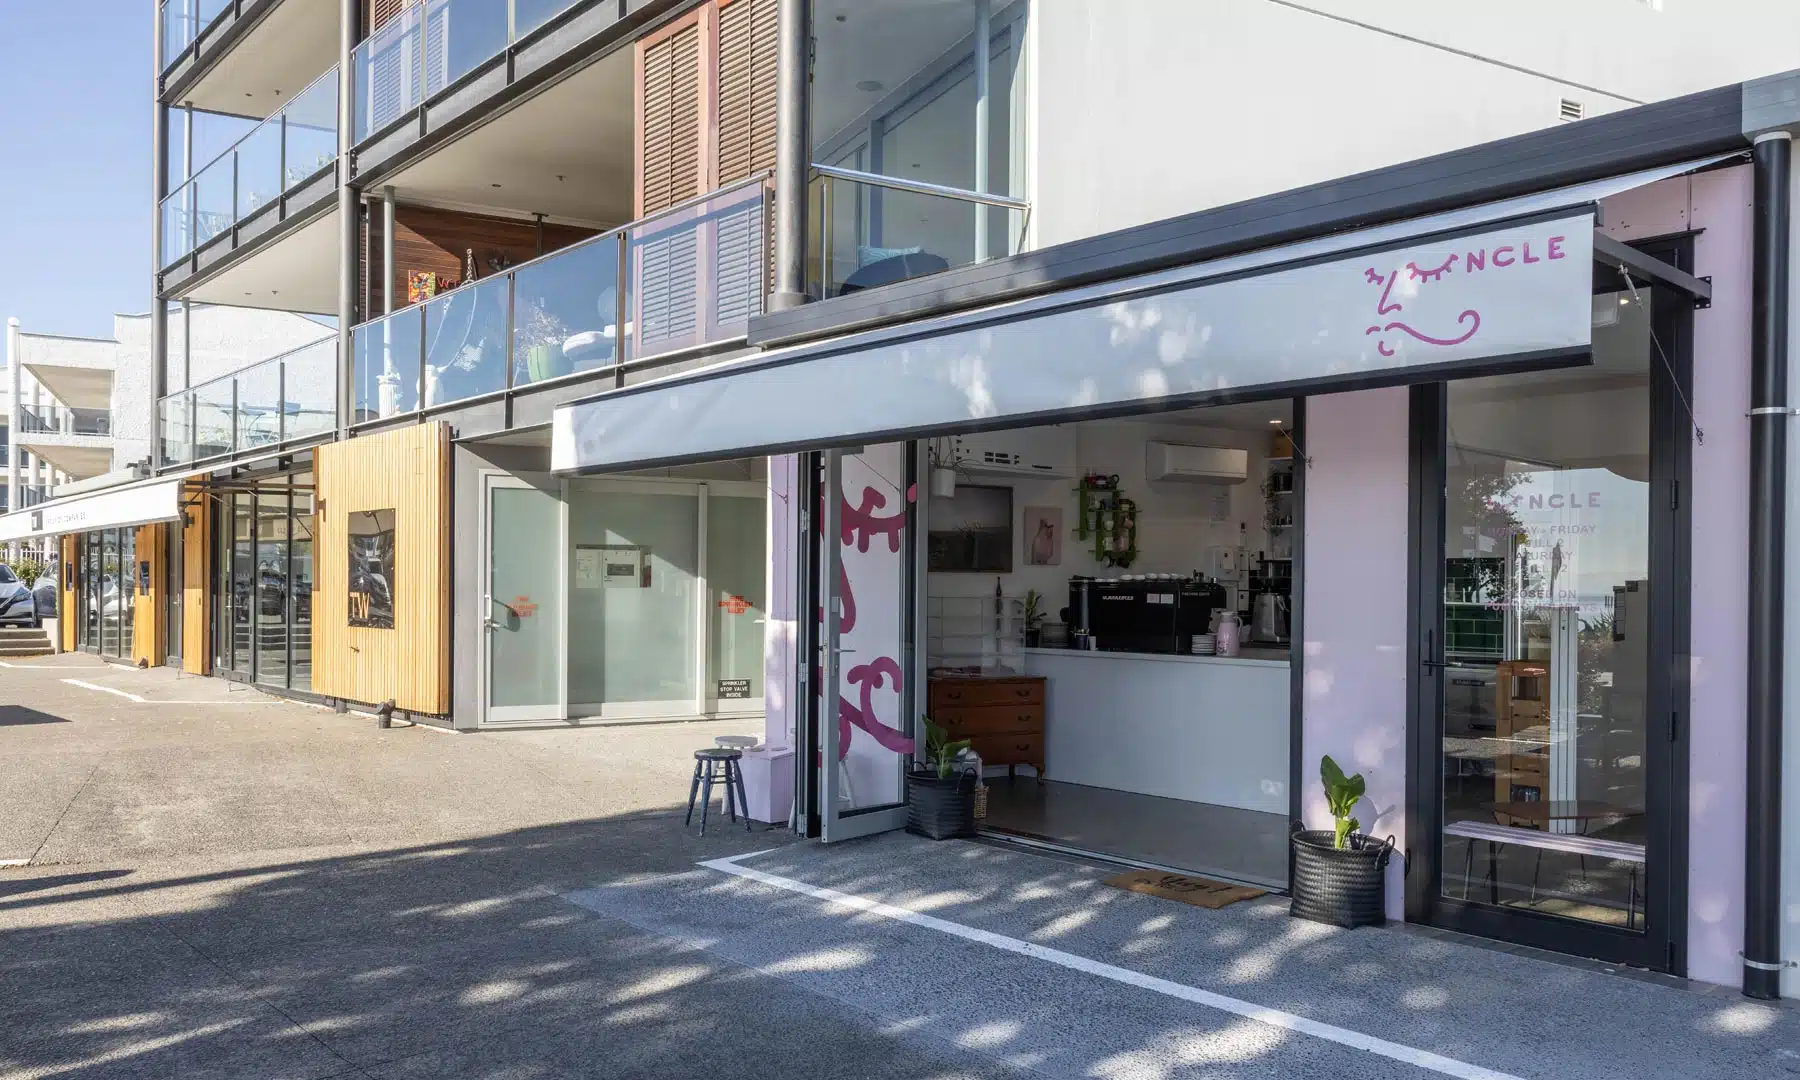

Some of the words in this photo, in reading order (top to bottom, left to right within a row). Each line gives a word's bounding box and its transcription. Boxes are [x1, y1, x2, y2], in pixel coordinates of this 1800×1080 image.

[1550, 525, 1597, 535] FRIDAY
[1507, 551, 1573, 561] ATURDAY
[1558, 589, 1577, 599] ON
[349, 591, 370, 619] TW
